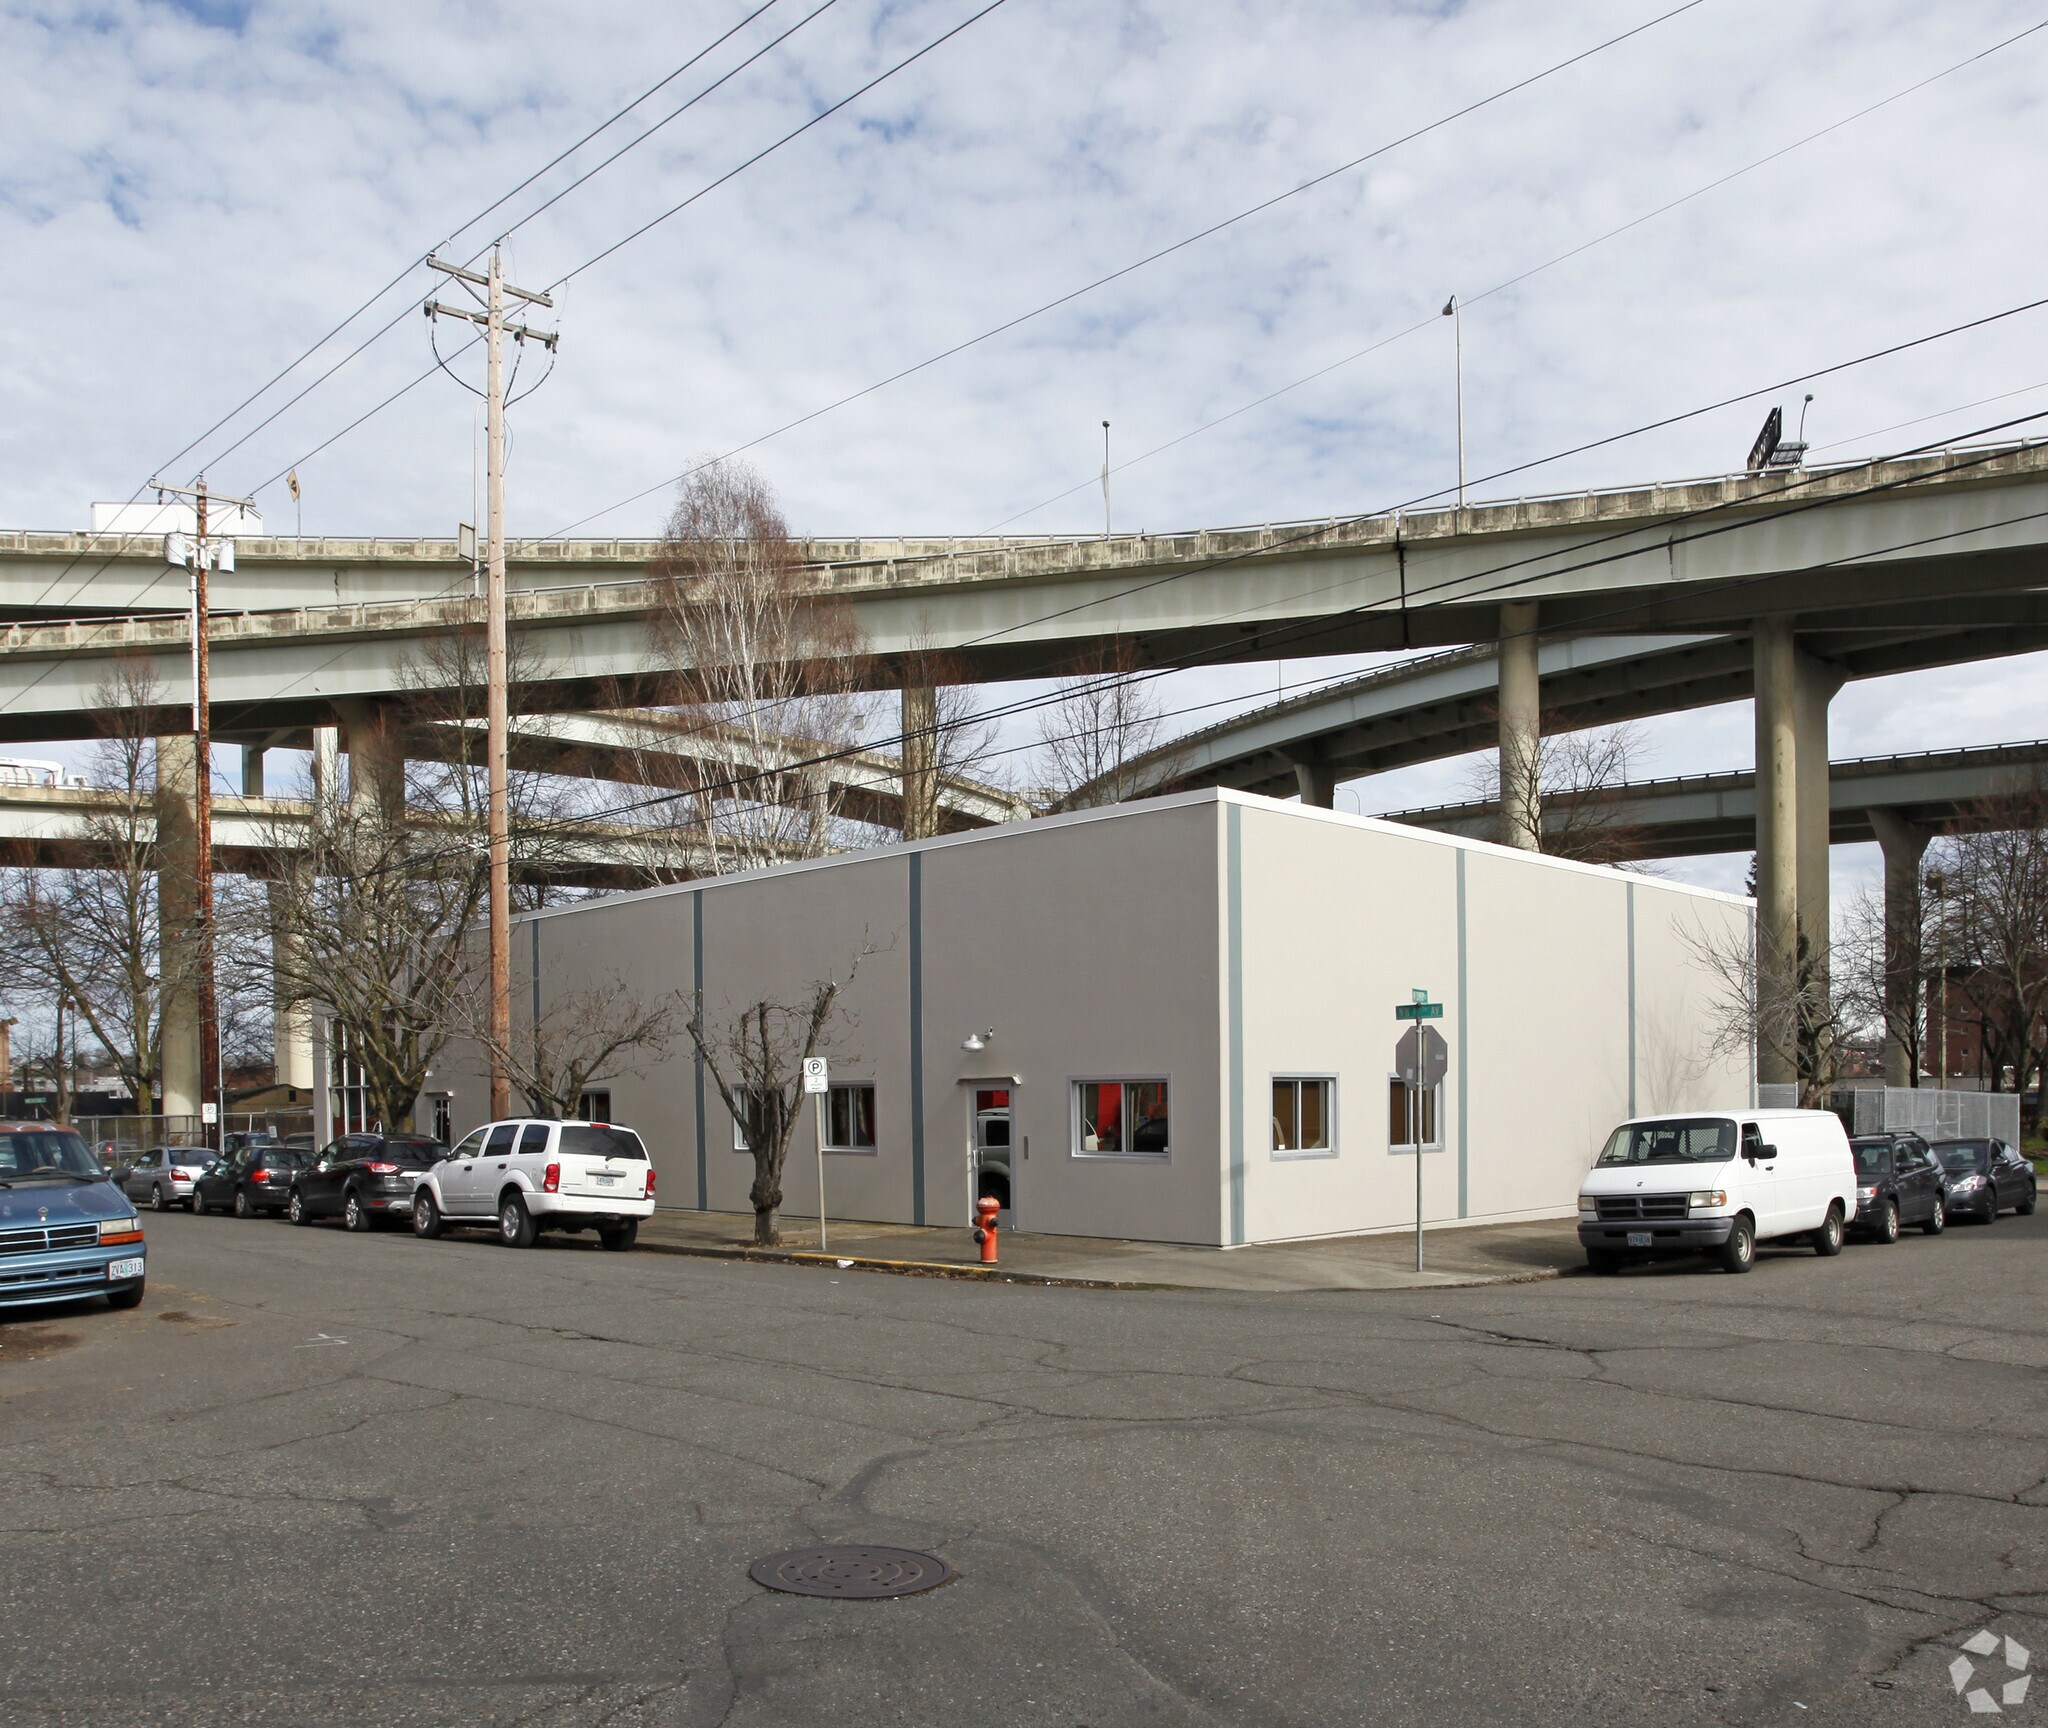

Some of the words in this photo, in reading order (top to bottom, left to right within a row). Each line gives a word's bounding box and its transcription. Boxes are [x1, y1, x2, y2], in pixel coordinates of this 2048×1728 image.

[812, 1062, 820, 1072] P
[111, 1264, 125, 1277] ZVA
[128, 1262, 143, 1273] 313
